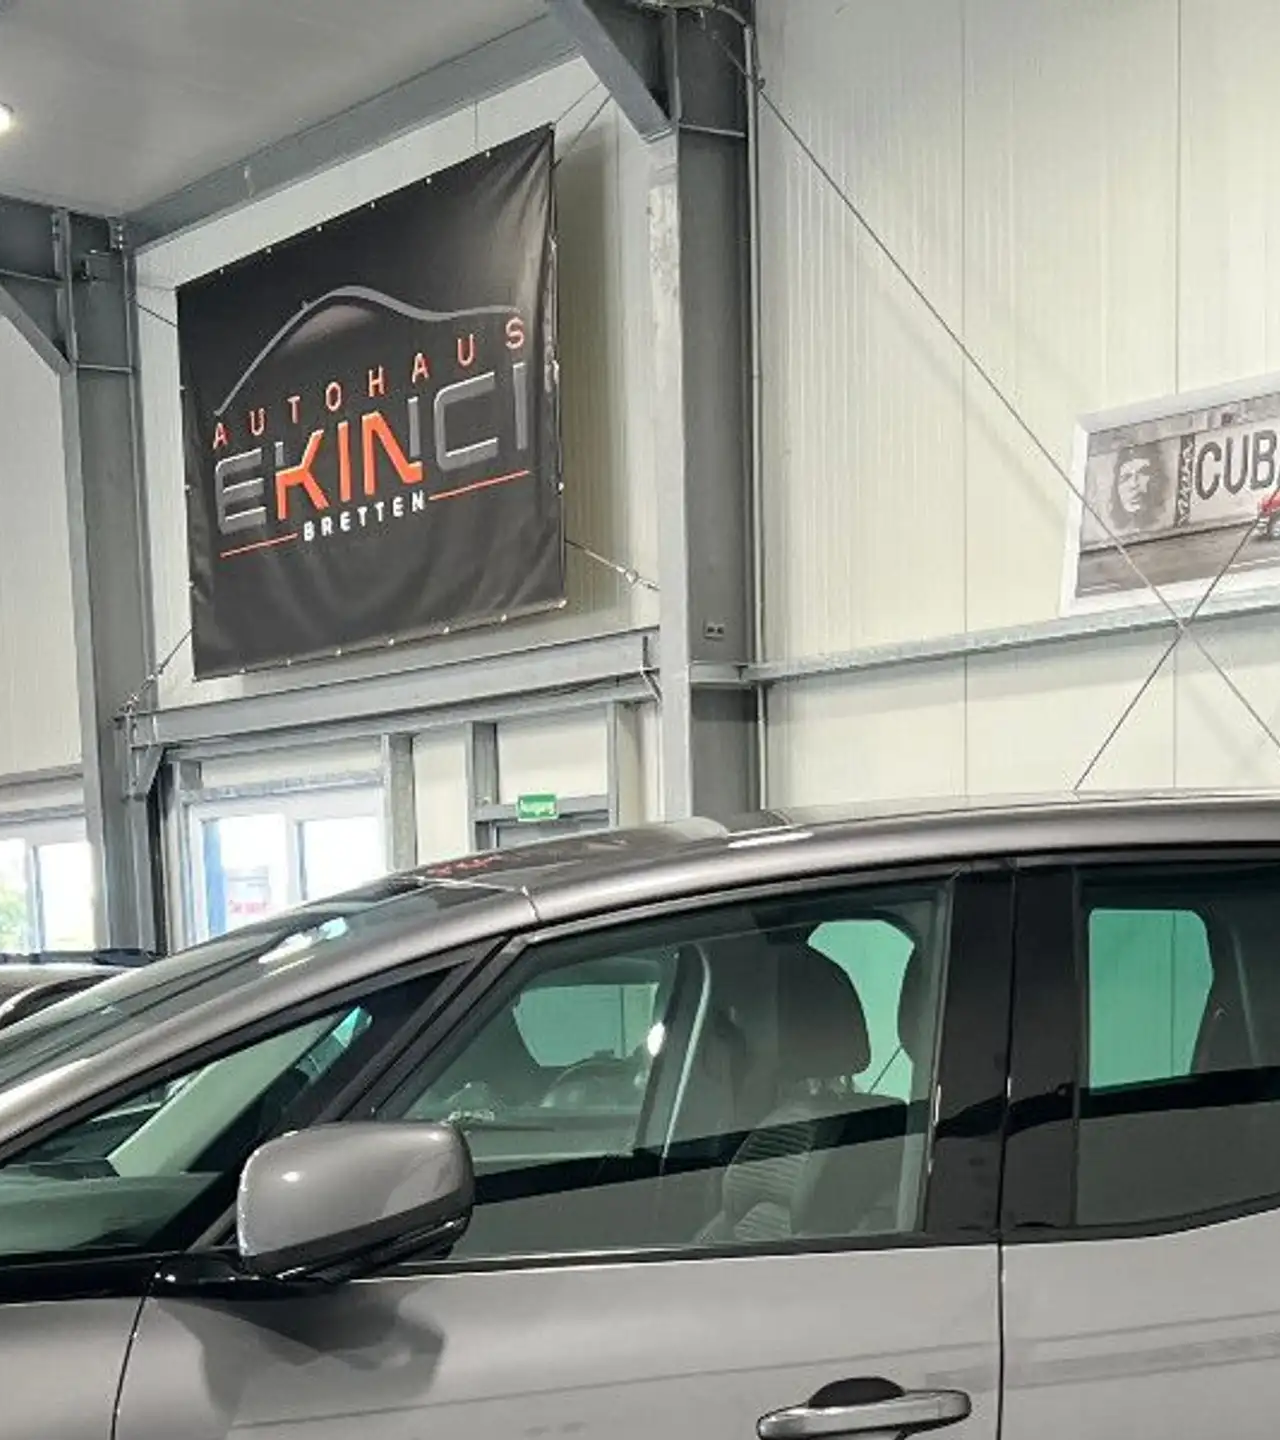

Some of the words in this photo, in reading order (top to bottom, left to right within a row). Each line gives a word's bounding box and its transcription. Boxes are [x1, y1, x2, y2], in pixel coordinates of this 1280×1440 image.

[213, 317, 525, 449] AUTOHAUS
[215, 363, 528, 535] EKINCI
[303, 490, 426, 542] BRETTEN
